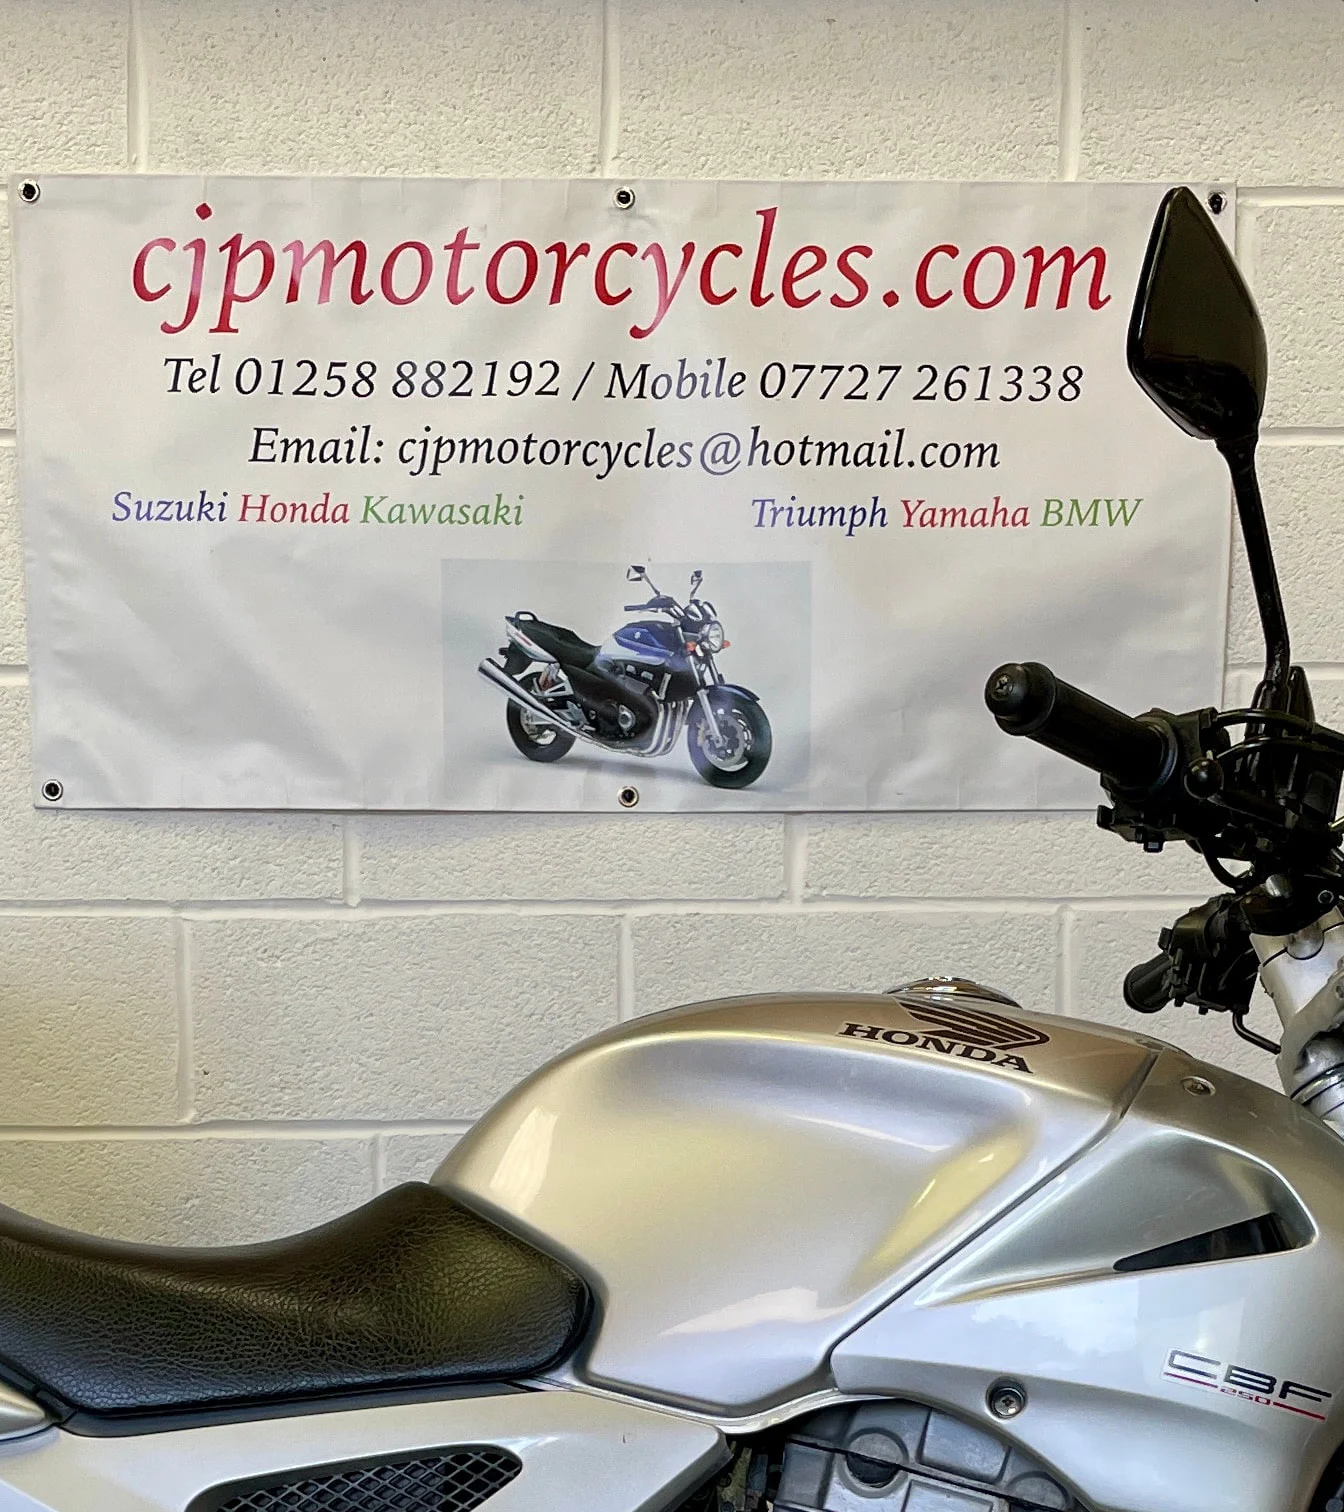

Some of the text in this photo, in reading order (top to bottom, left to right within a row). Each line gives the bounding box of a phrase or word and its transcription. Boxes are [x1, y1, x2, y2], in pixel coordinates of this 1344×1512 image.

[132, 202, 1112, 341] cjpmotorcycles.com
[163, 352, 1085, 403] Tel 01258 882192 / Mobile 07727 261338
[248, 423, 1001, 481] Email: cjpmotorcycles@hotmail.com
[111, 489, 525, 527] Suzuki Honda Kawasaki
[751, 495, 1145, 539] Triumph Yamaha BMW
[839, 1022, 1033, 1074] HONDA
[1168, 1349, 1333, 1402] CBF
[1220, 1385, 1271, 1406] 250
